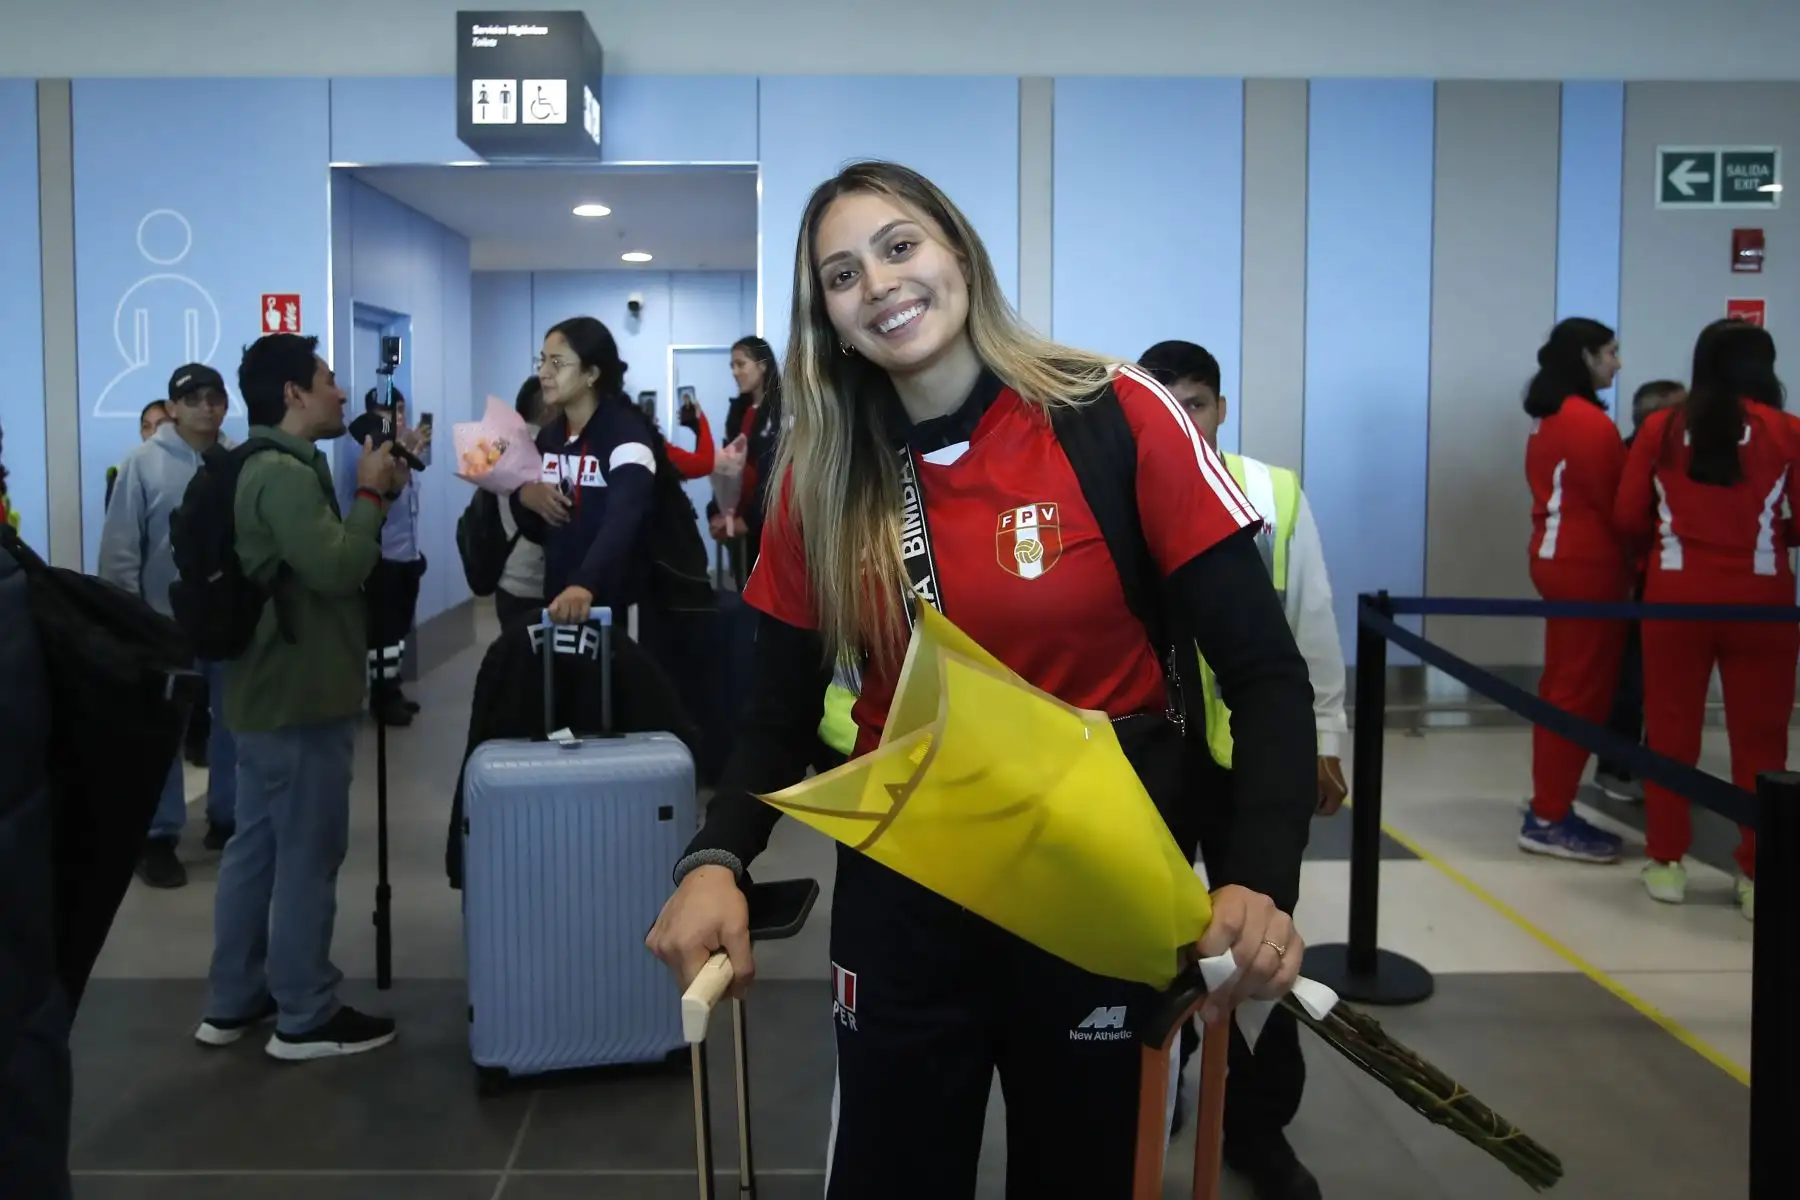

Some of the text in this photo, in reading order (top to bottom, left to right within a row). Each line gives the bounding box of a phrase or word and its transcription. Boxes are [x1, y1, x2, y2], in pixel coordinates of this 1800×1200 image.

[1726, 164, 1769, 176] SALIDA
[1734, 178, 1760, 191] EXIT
[1069, 1029, 1132, 1041] New Athletic
